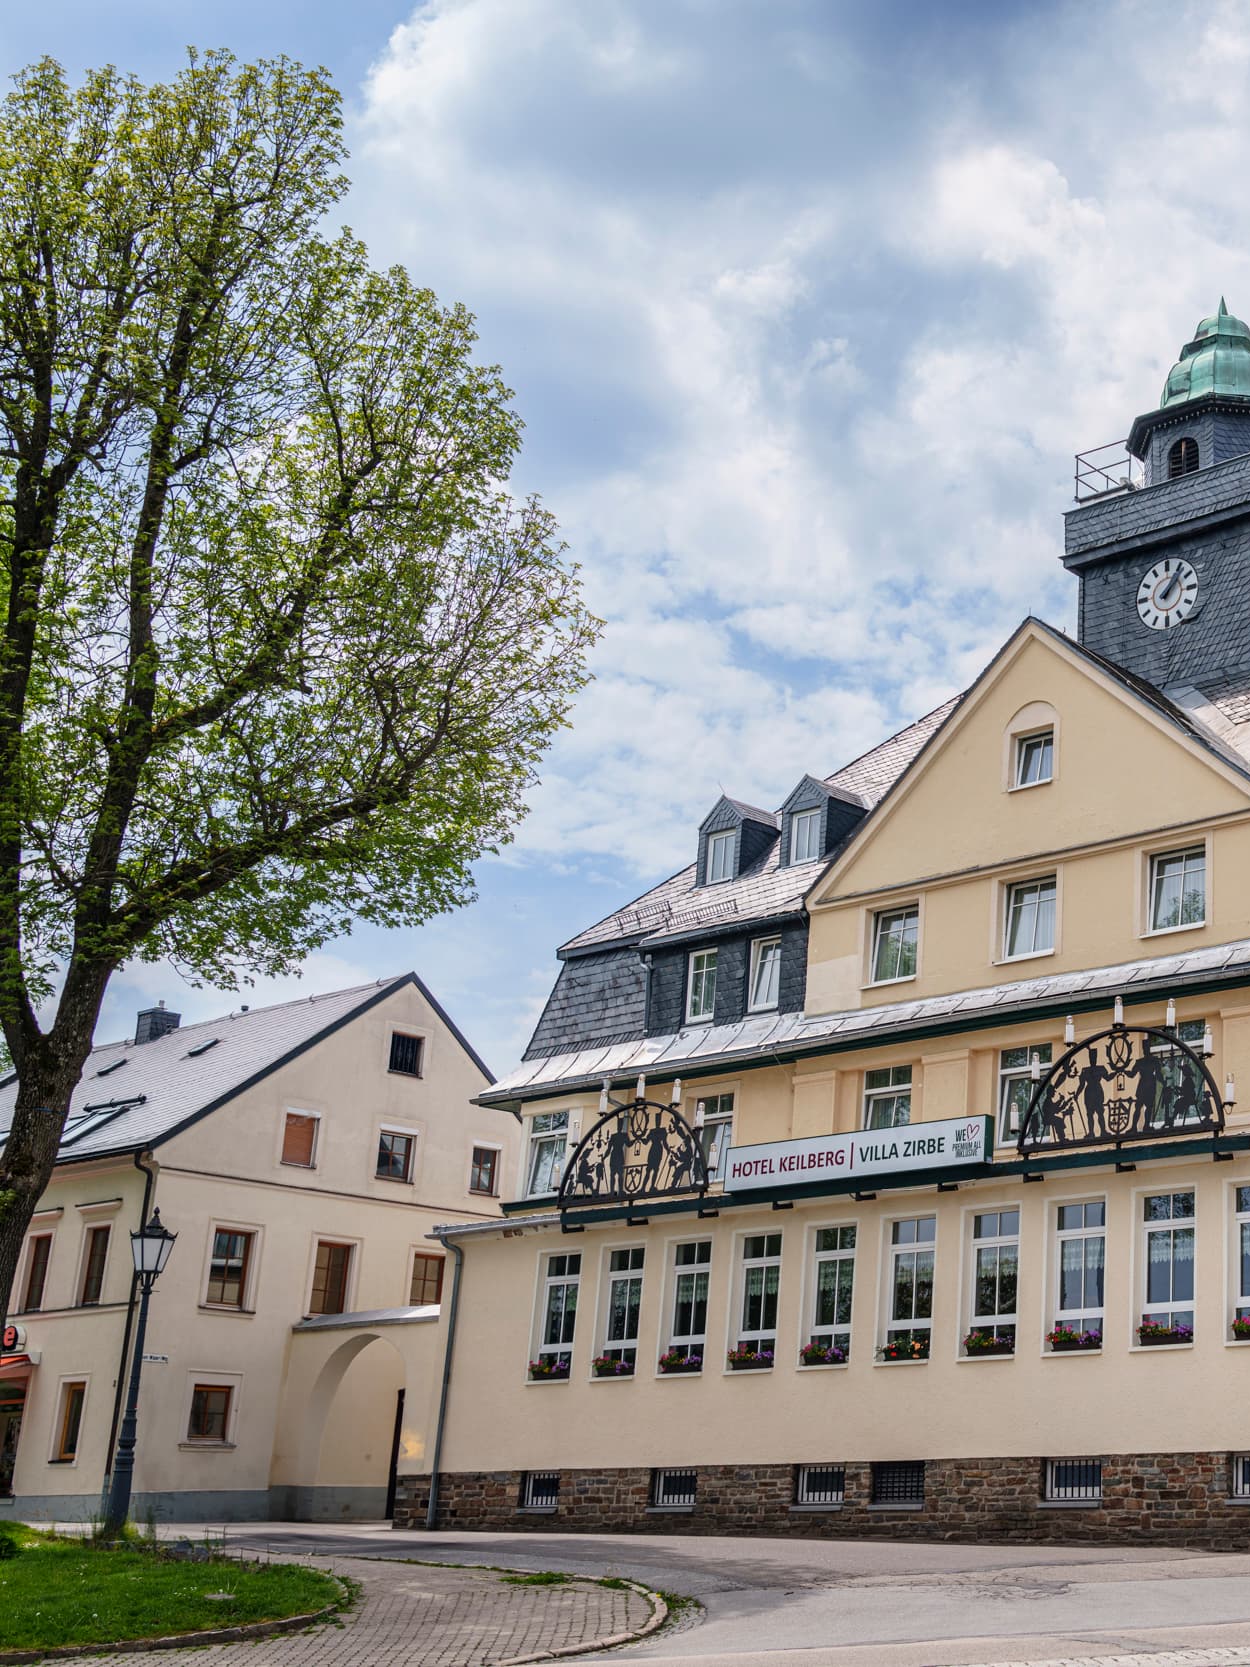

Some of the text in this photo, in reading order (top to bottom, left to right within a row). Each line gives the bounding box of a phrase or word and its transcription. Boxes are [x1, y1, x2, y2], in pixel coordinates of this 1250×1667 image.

[955, 1129, 966, 1142] WE
[952, 1140, 982, 1152] PREMIUM ALL
[732, 1137, 945, 1178] HOTEL KEILBERG VILLA ZIRBE
